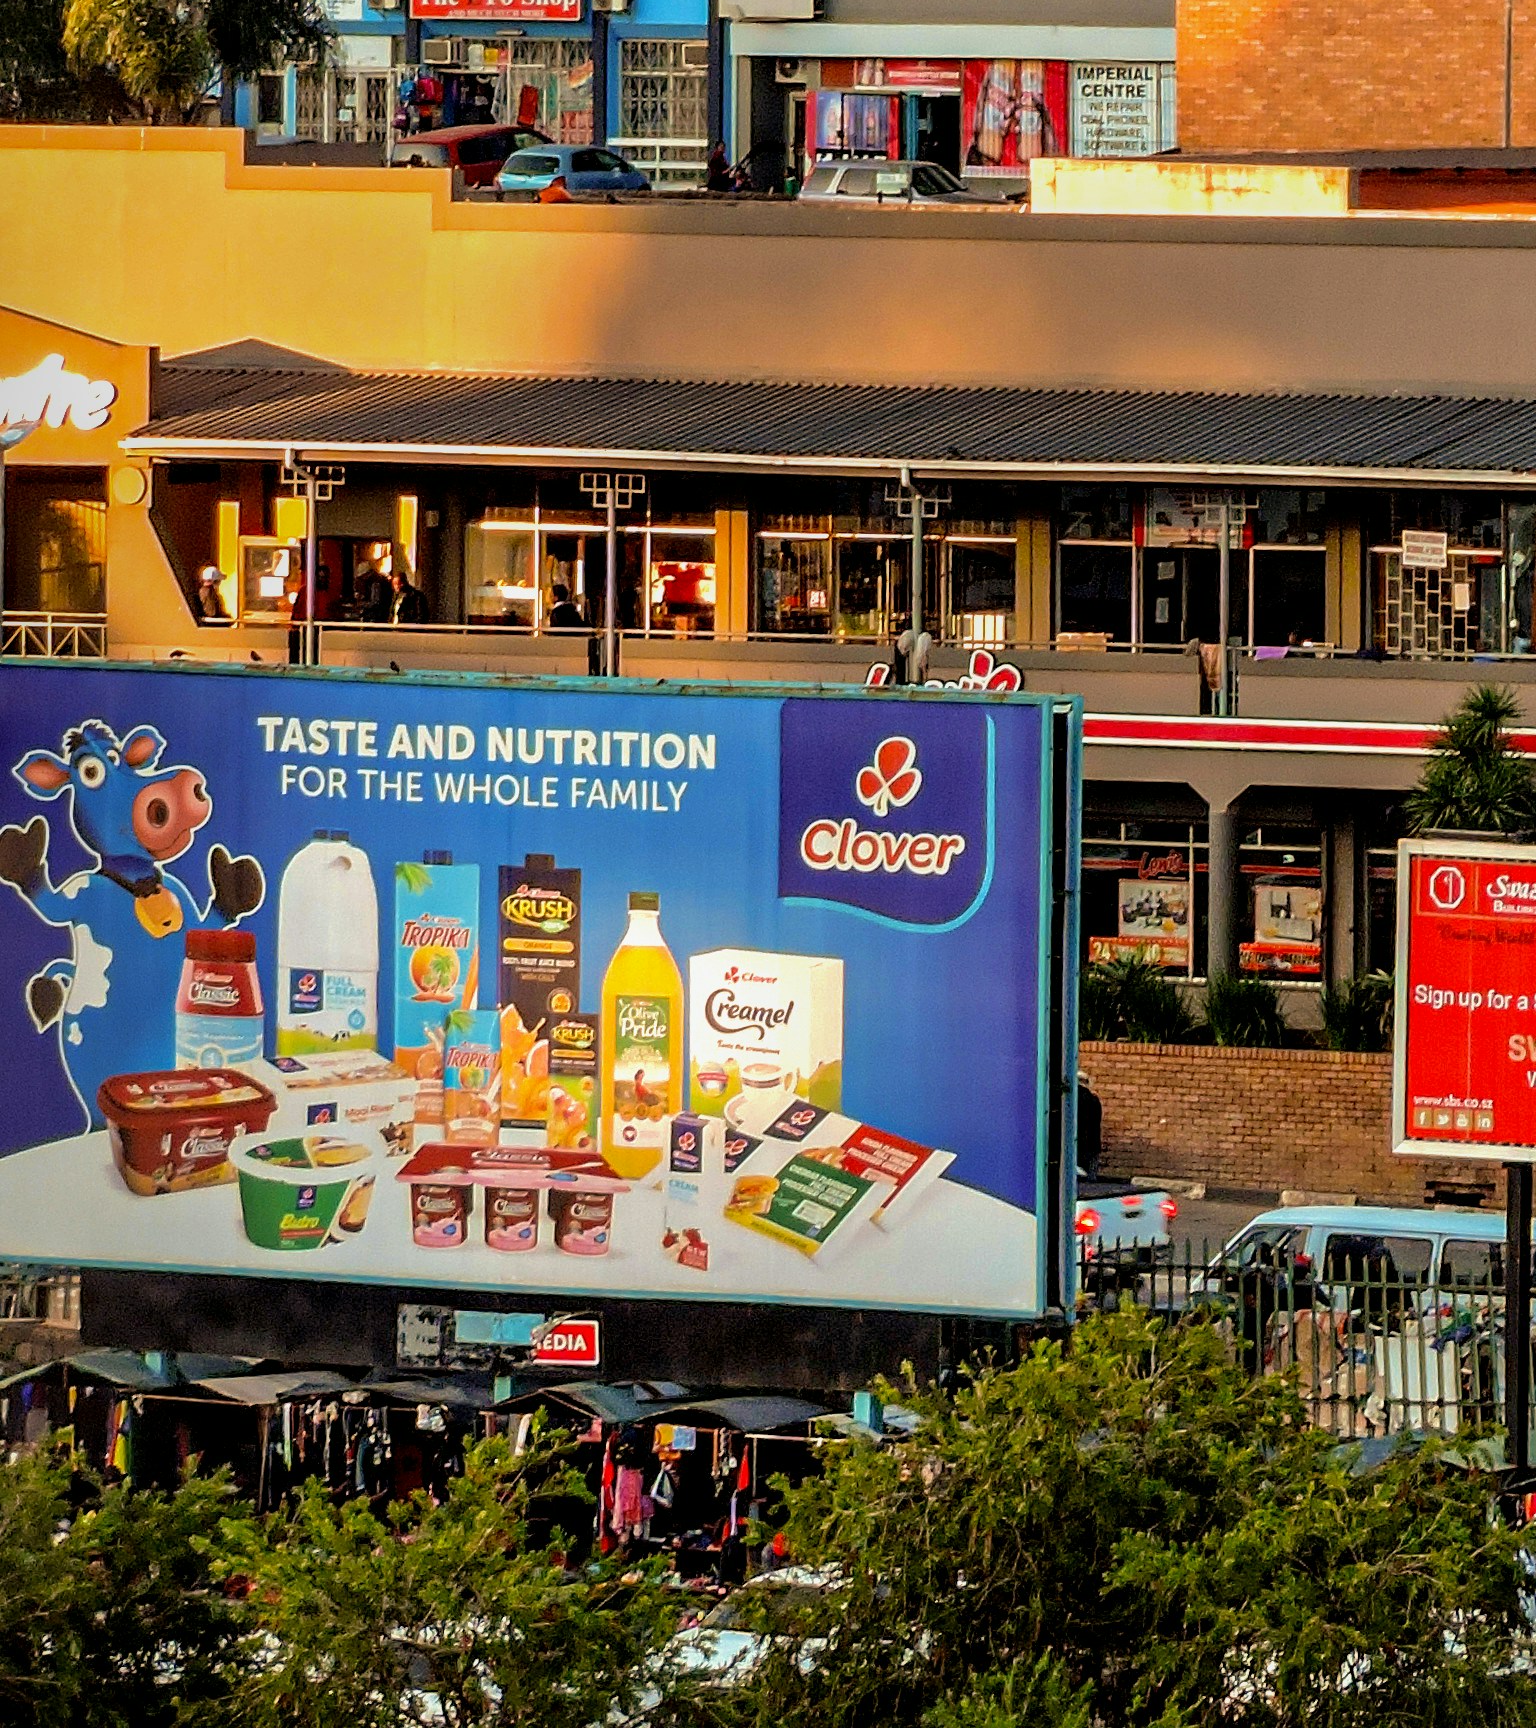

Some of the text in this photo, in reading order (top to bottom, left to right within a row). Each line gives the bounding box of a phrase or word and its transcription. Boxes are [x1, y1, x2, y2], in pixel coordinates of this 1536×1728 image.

[1077, 67, 1153, 81] IMPERIAL
[1081, 83, 1147, 98] CENTRE
[257, 716, 717, 770] TASTE AND NUTRITION
[281, 765, 688, 812] FOR THE WHOLE FAMILY
[801, 818, 966, 876] Clover
[1138, 849, 1184, 880] Lewis
[506, 899, 572, 919] KRUSH
[402, 921, 469, 948] TROPIKA
[326, 976, 353, 986] FULL
[742, 973, 777, 983] Clover
[189, 982, 240, 1004] Classic
[326, 986, 367, 997] CREAM
[1414, 985, 1454, 1010] Sign
[1458, 991, 1482, 1011] up
[1487, 989, 1511, 1010] for
[1516, 996, 1529, 1011] a
[628, 1005, 659, 1020] Olive
[705, 988, 794, 1040] Creamel
[553, 1027, 594, 1040] KRUSH
[621, 1017, 667, 1039] Pride
